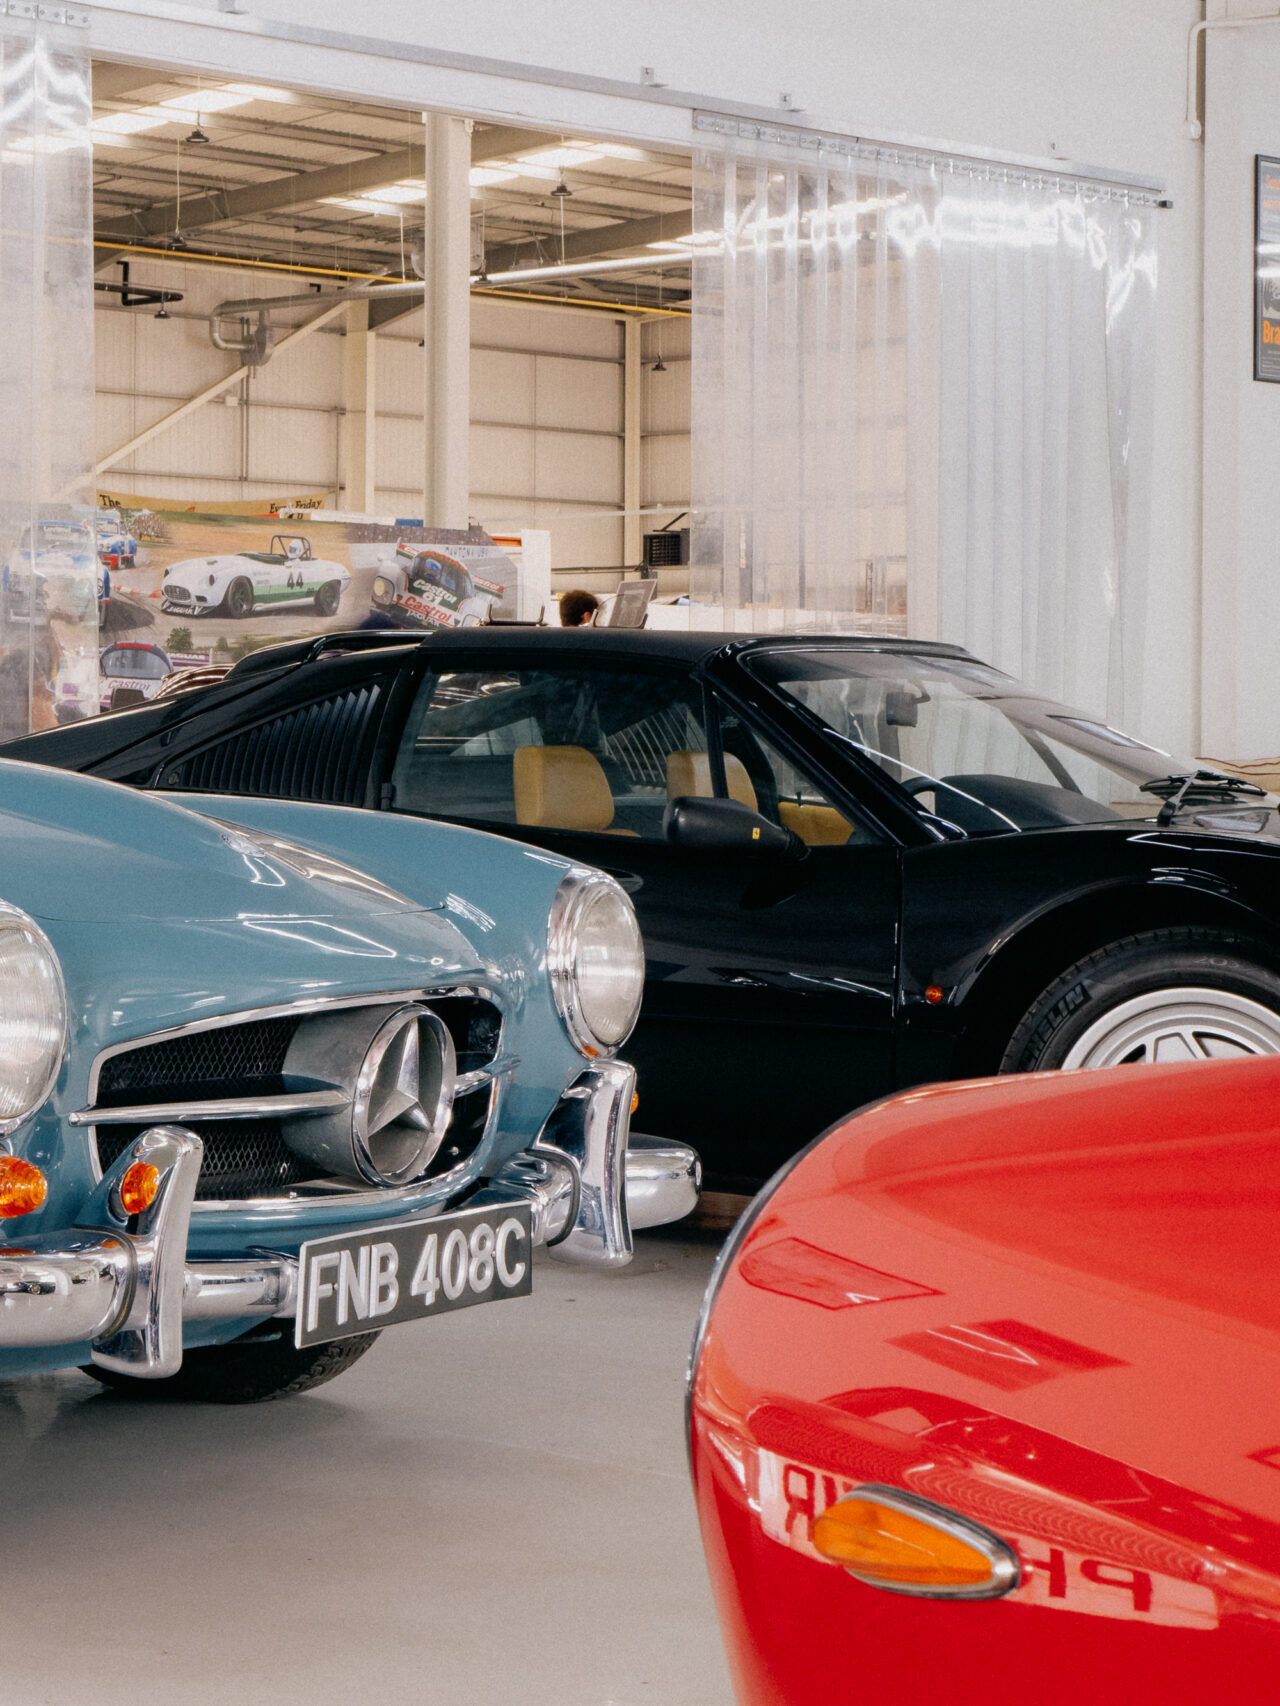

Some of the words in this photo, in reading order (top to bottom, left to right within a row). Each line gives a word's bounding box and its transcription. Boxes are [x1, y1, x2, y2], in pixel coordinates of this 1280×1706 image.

[287, 572, 304, 590] 44
[413, 579, 458, 604] Castrol
[404, 595, 453, 622] Castrol
[108, 679, 151, 692] Castrol
[307, 1241, 400, 1332] FNB
[410, 1217, 526, 1306] 408C
